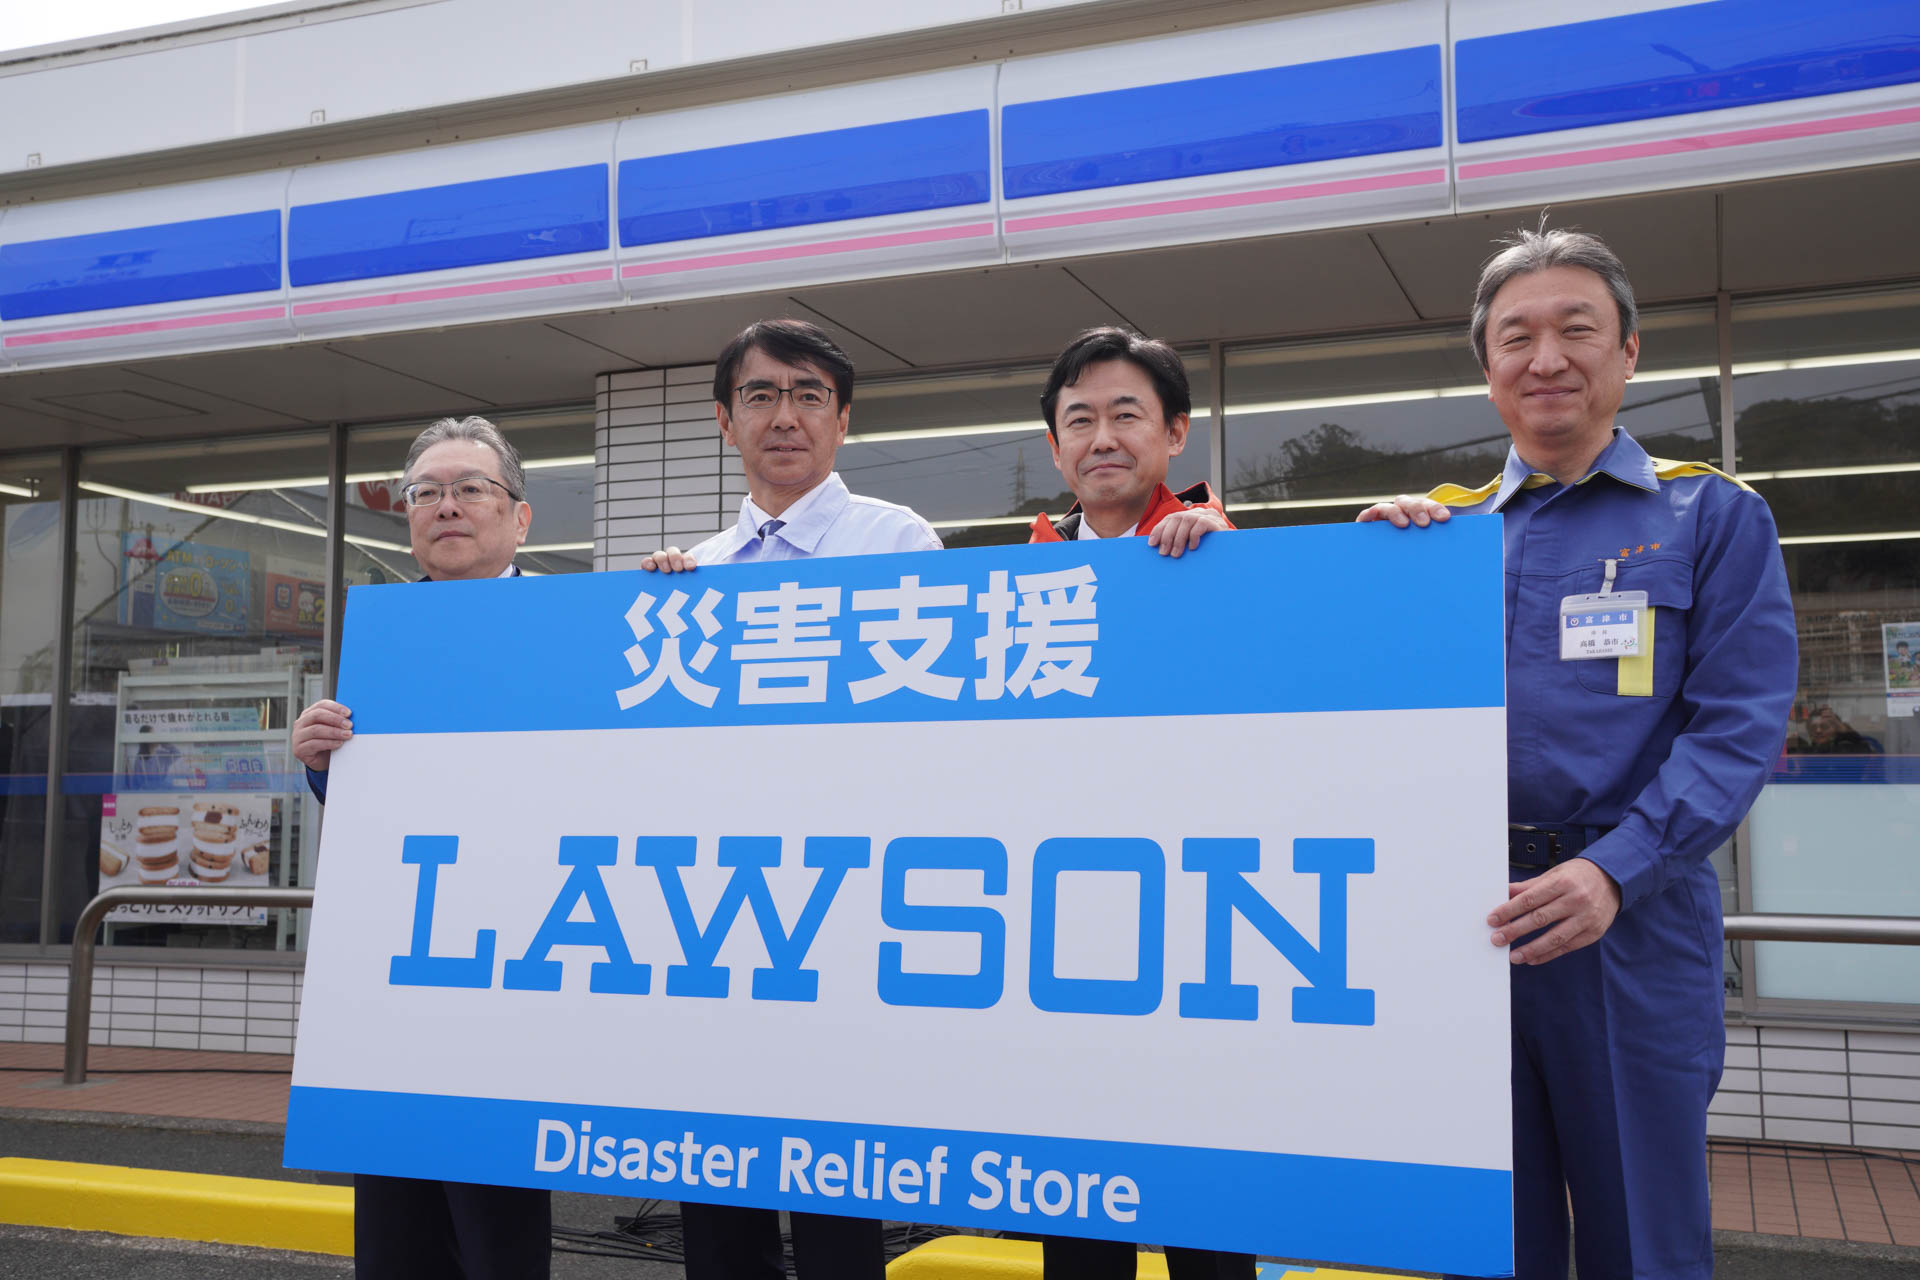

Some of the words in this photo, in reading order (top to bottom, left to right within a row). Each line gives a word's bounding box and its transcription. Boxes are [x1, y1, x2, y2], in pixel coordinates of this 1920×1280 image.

[616, 564, 1100, 711] 災害支援
[389, 835, 1375, 1026] LAWSON
[535, 1120, 758, 1188] Disaster
[780, 1137, 948, 1206] Relief
[968, 1151, 1139, 1222] Store
